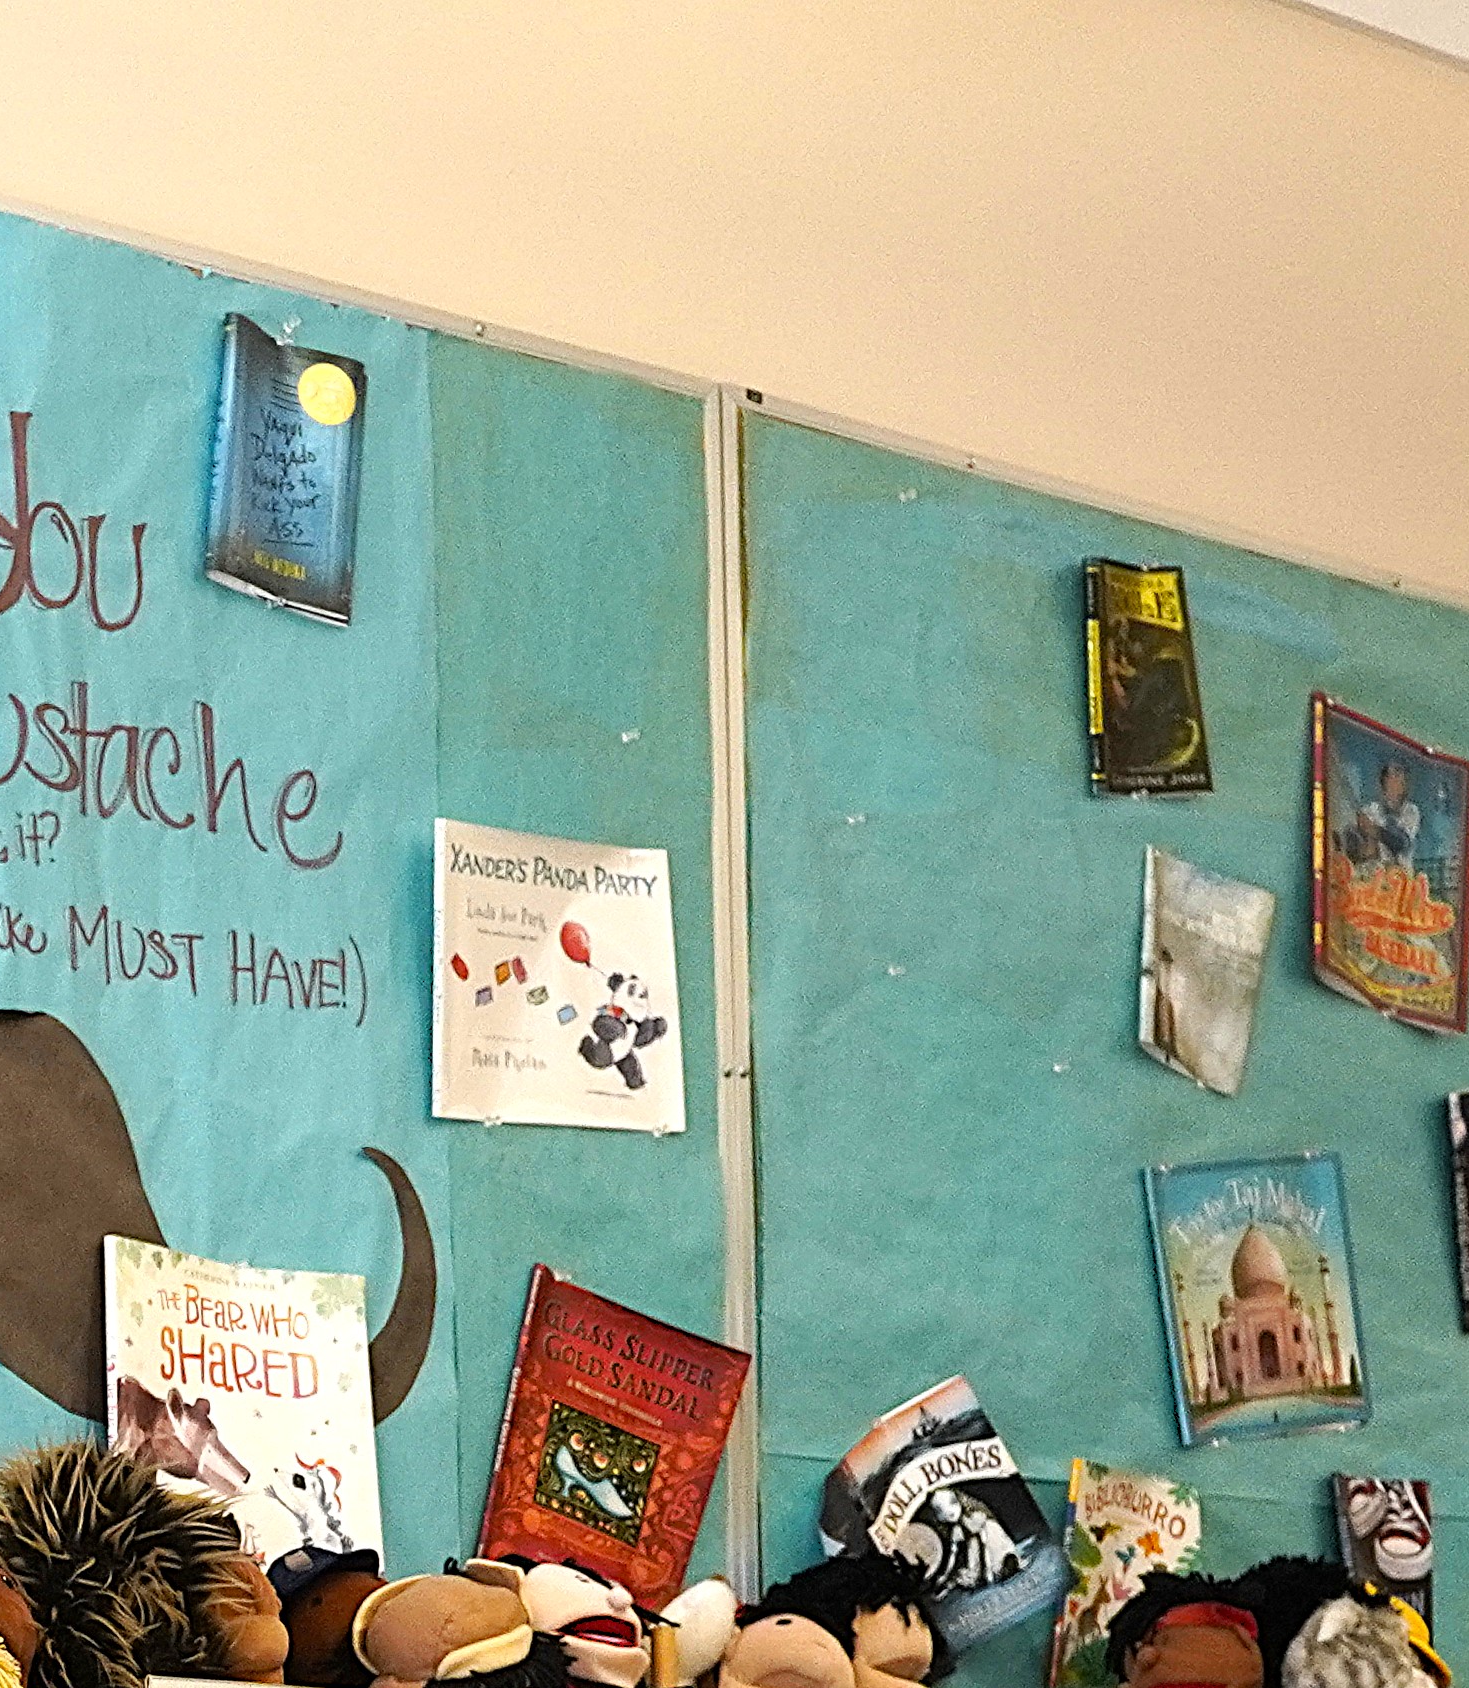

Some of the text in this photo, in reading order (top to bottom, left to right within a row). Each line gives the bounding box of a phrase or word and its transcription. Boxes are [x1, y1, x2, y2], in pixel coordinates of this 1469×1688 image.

[15, 811, 61, 866] it?
[450, 842, 658, 898] XANDER'S PANDA PARTY
[69, 906, 204, 996] MUST
[229, 930, 367, 1026] HAVE!)
[250, 1302, 310, 1339] WHO
[541, 1301, 716, 1390] GLASS SLIPPER
[543, 1332, 604, 1379] GOLD
[610, 1362, 703, 1421] SANDAL
[883, 1444, 1003, 1536] DOLL BONES
